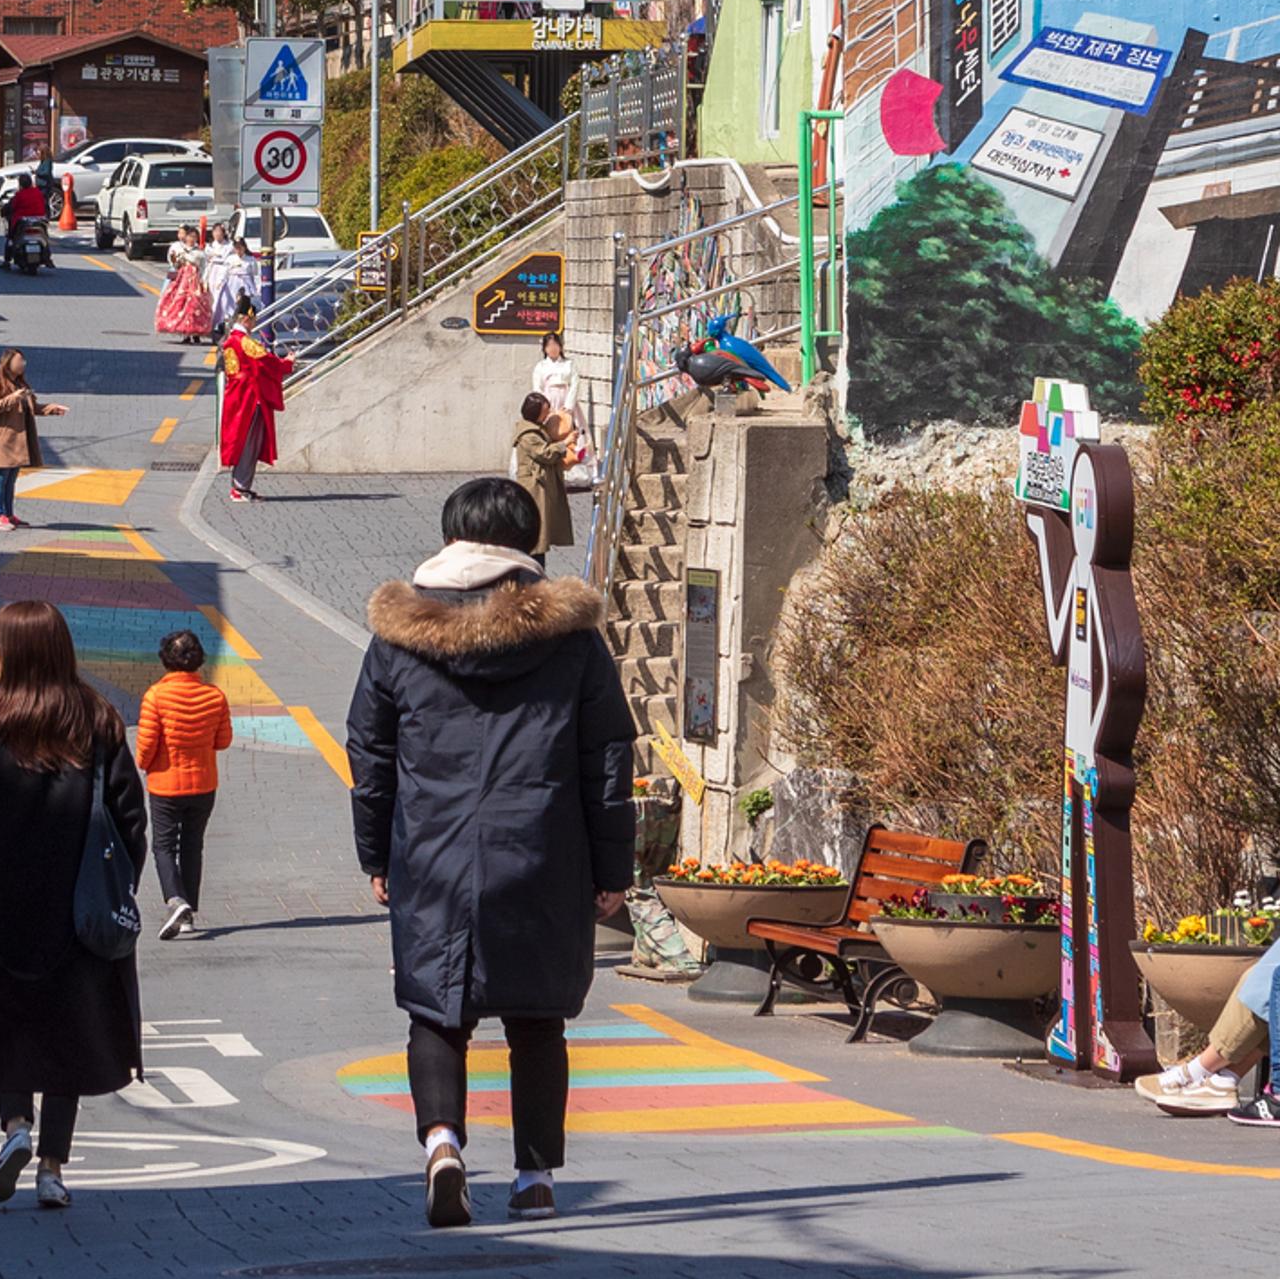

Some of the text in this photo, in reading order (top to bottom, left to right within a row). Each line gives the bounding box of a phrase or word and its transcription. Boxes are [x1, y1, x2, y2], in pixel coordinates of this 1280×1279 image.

[532, 16, 602, 40] 감내카페
[1047, 31, 1163, 70] 벽화 제작 정보
[100, 67, 162, 81] 관광기념품
[267, 147, 295, 169] 30
